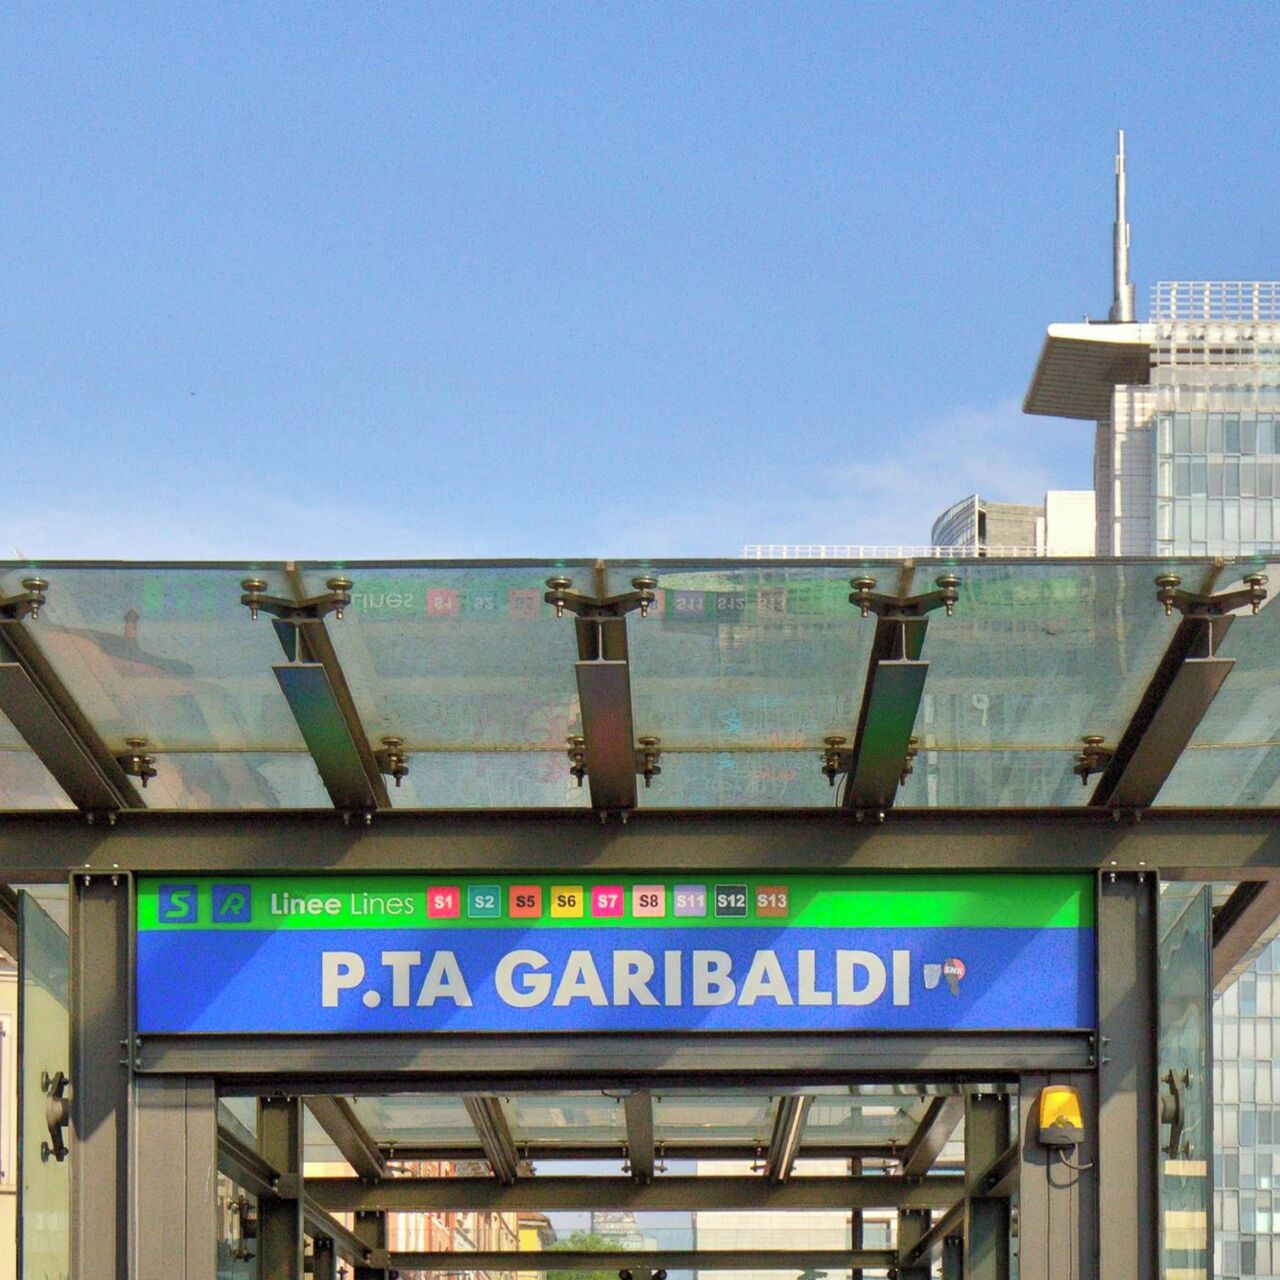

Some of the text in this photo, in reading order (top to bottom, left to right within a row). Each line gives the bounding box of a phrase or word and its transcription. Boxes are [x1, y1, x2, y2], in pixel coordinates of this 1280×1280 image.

[271, 893, 342, 915] Linee
[351, 893, 414, 915] Lines
[434, 896, 452, 909] S1
[474, 895, 494, 909] S2
[516, 895, 535, 909] S5
[557, 895, 576, 908] S6
[598, 895, 618, 908] S7
[639, 894, 659, 908] S8
[676, 894, 705, 908] S11
[717, 894, 746, 908] S12
[757, 894, 787, 908] S13
[322, 950, 910, 1008] P.TA GARIBALDI
